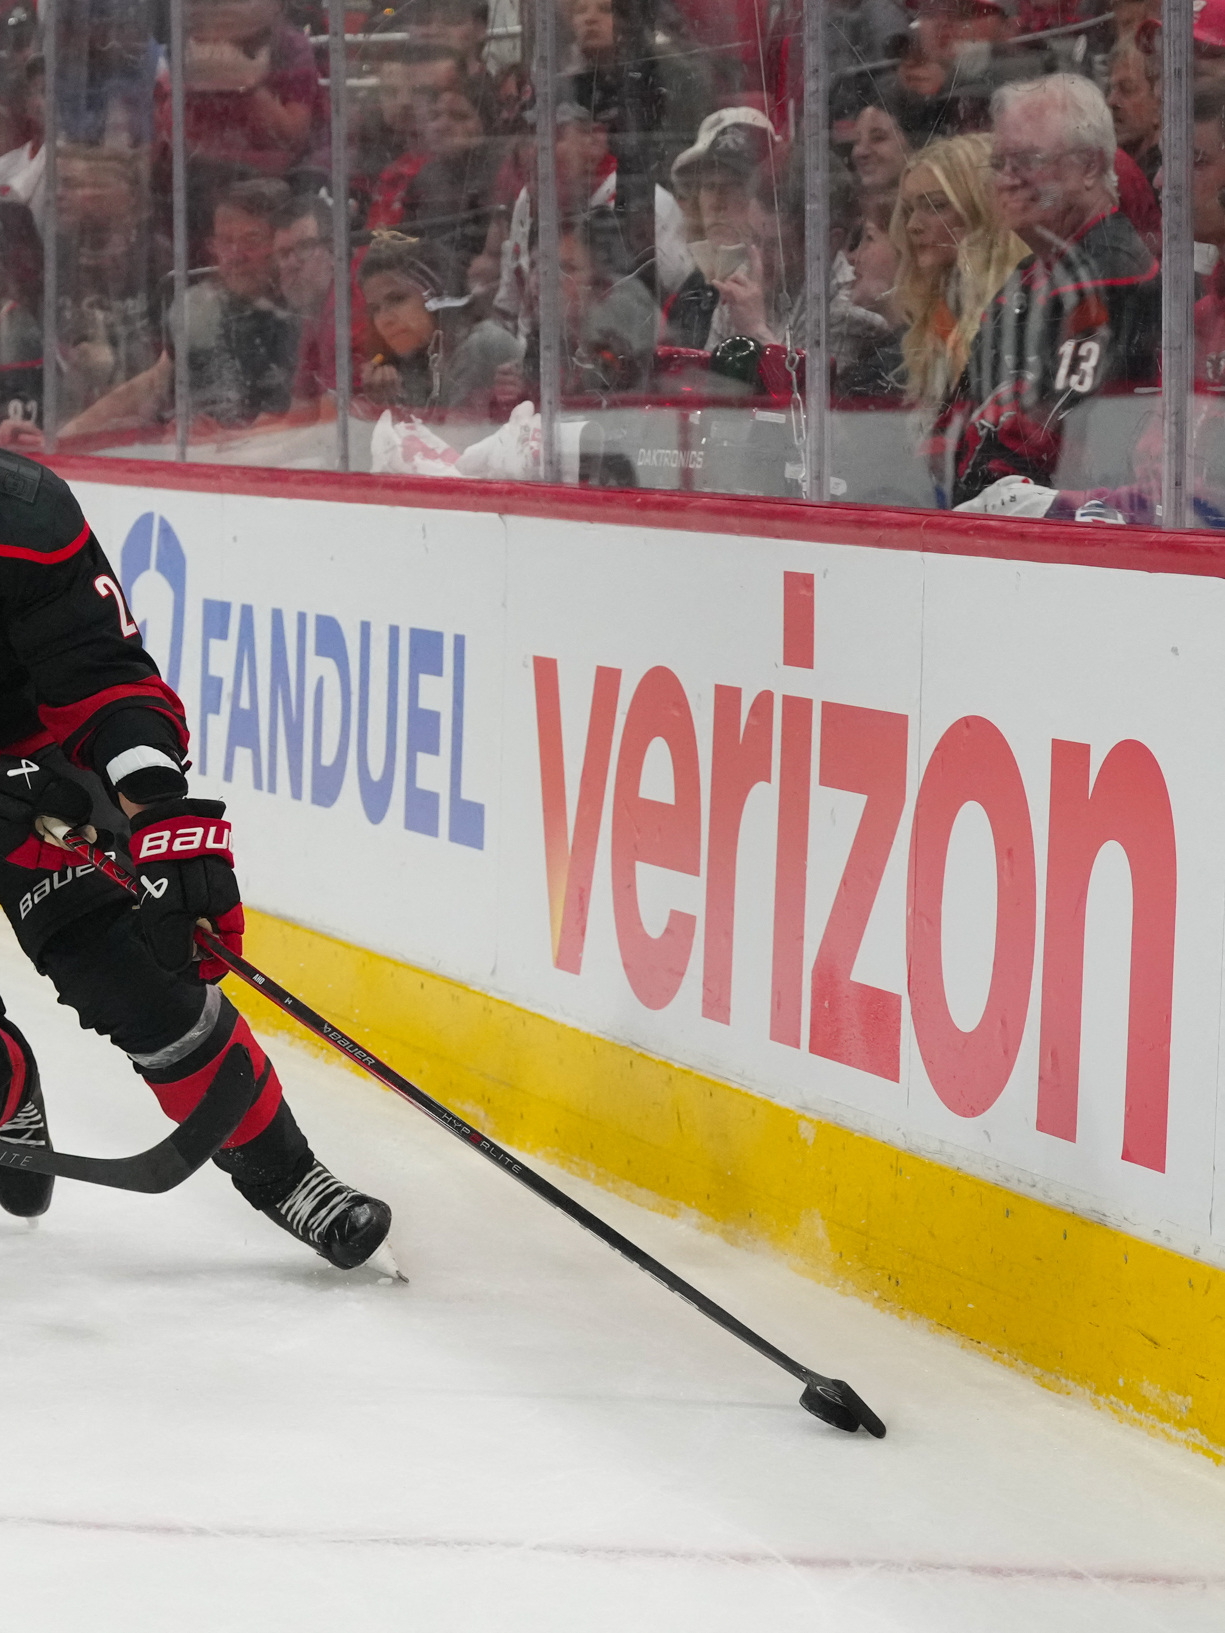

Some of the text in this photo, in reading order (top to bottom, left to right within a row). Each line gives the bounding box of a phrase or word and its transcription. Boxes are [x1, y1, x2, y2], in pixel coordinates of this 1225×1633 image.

[1054, 338, 1100, 394] 13
[637, 448, 705, 469] DAKTRONICS
[197, 597, 486, 852] FANDUEL
[532, 569, 1178, 1175] verizon
[328, 1031, 376, 1067] BAUER
